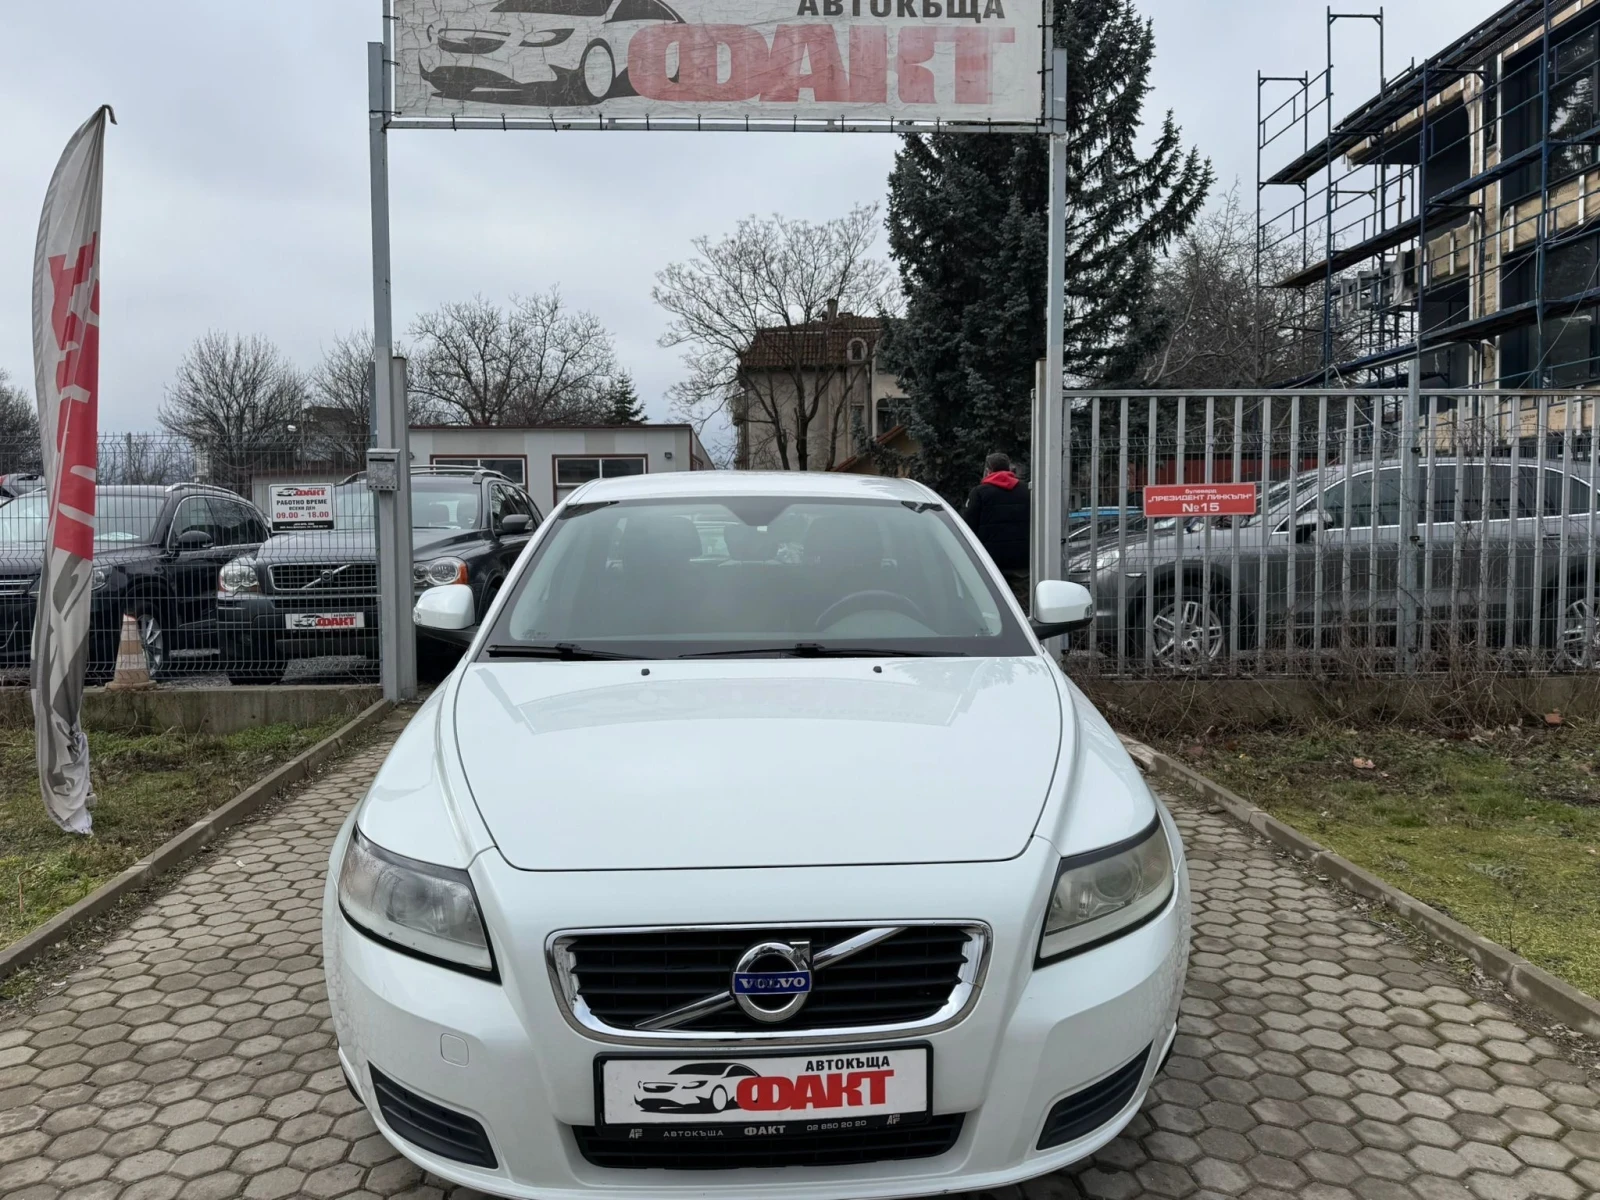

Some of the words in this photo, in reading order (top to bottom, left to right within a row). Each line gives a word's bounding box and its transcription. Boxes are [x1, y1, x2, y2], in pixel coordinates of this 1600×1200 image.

[797, 0, 1005, 23] АВТОКЪЩА
[628, 24, 1015, 104] ФАКТ
[317, 617, 356, 626] ФАКТ
[739, 977, 806, 989] VOLVO
[805, 1055, 891, 1072] АВТОКЪЩА
[736, 1069, 895, 1112] ФАКТ
[744, 1125, 787, 1136] ФАКТ
[821, 1122, 839, 1130] 850
